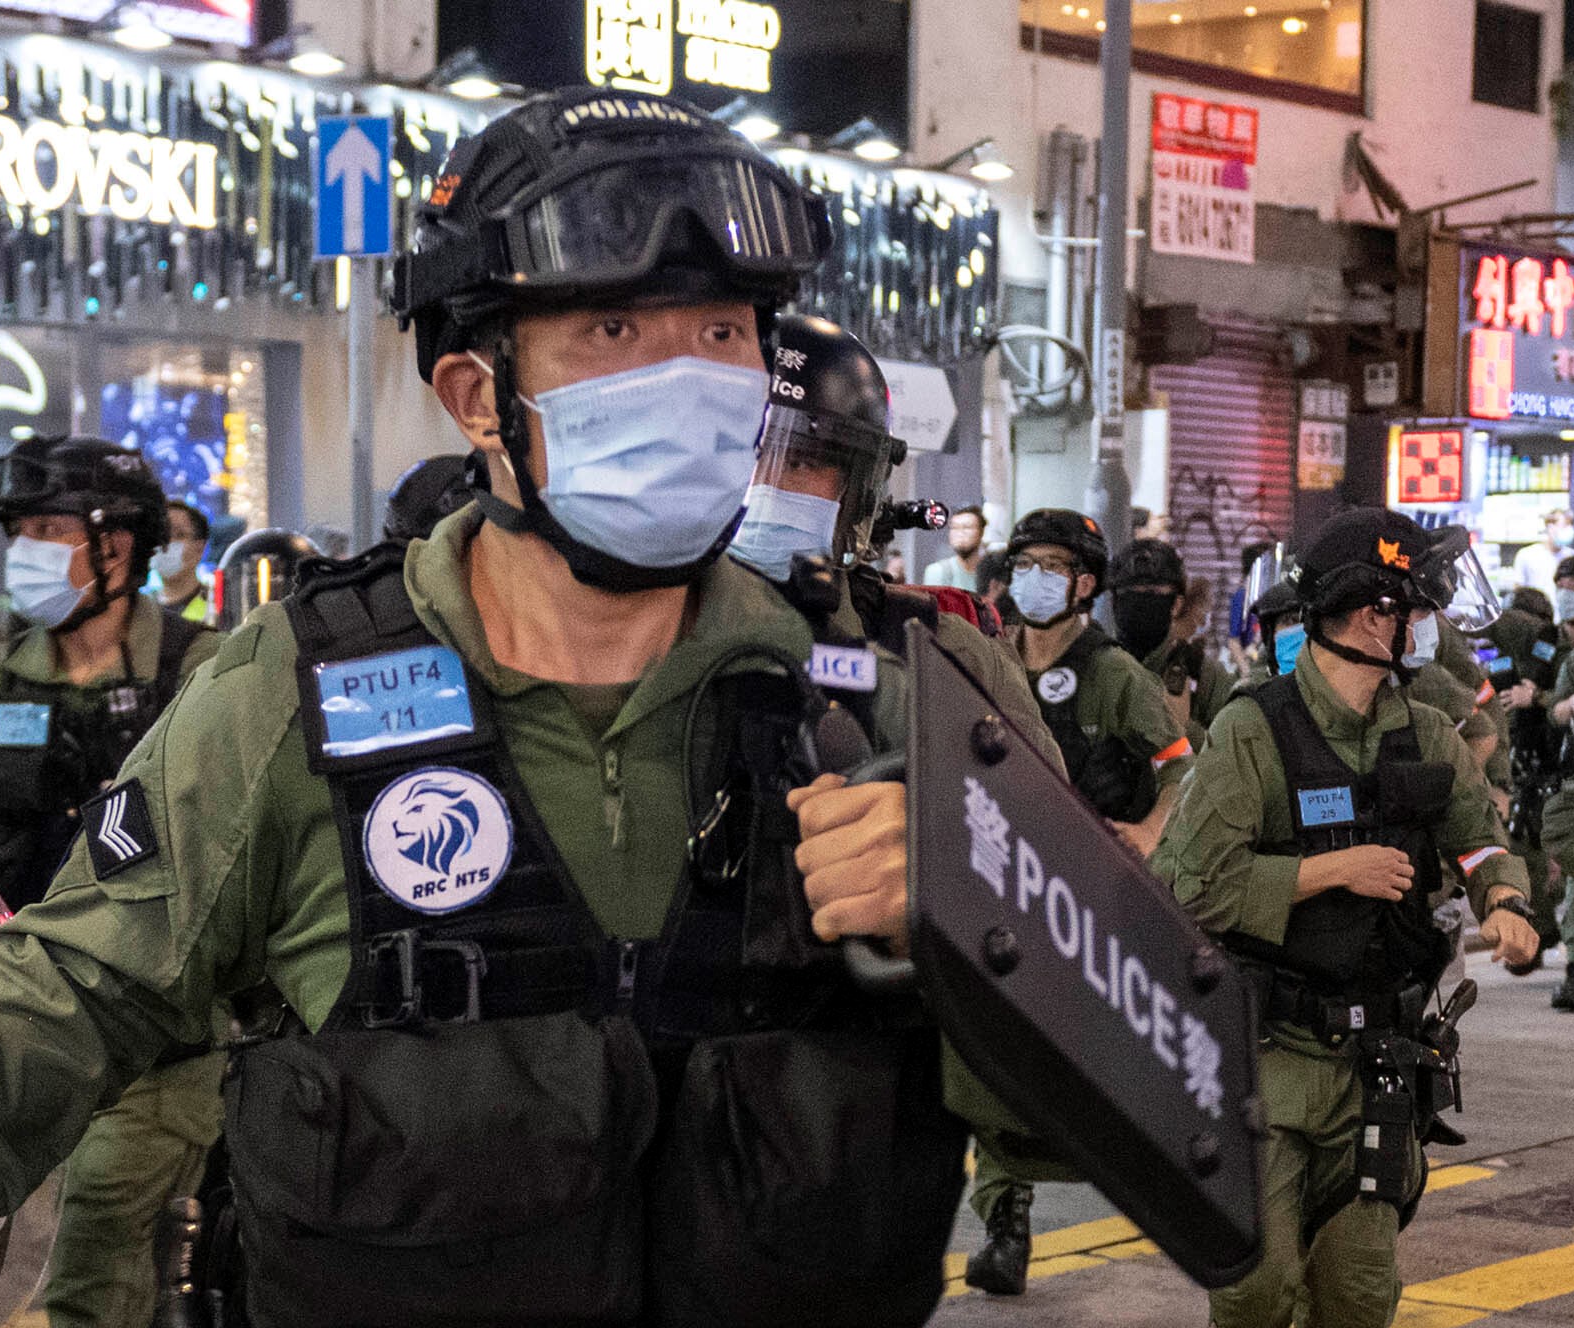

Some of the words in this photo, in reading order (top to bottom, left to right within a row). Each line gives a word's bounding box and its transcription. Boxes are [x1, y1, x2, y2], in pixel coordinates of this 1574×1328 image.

[772, 374, 806, 400] ice
[343, 667, 399, 697] PTU
[409, 660, 441, 685] F4
[810, 654, 865, 680] LICE
[379, 706, 417, 730] 1/1
[1307, 794, 1329, 805] PTU
[412, 877, 447, 899] RRC
[456, 867, 490, 888] NTS
[1016, 836, 1177, 1070] POLICE
